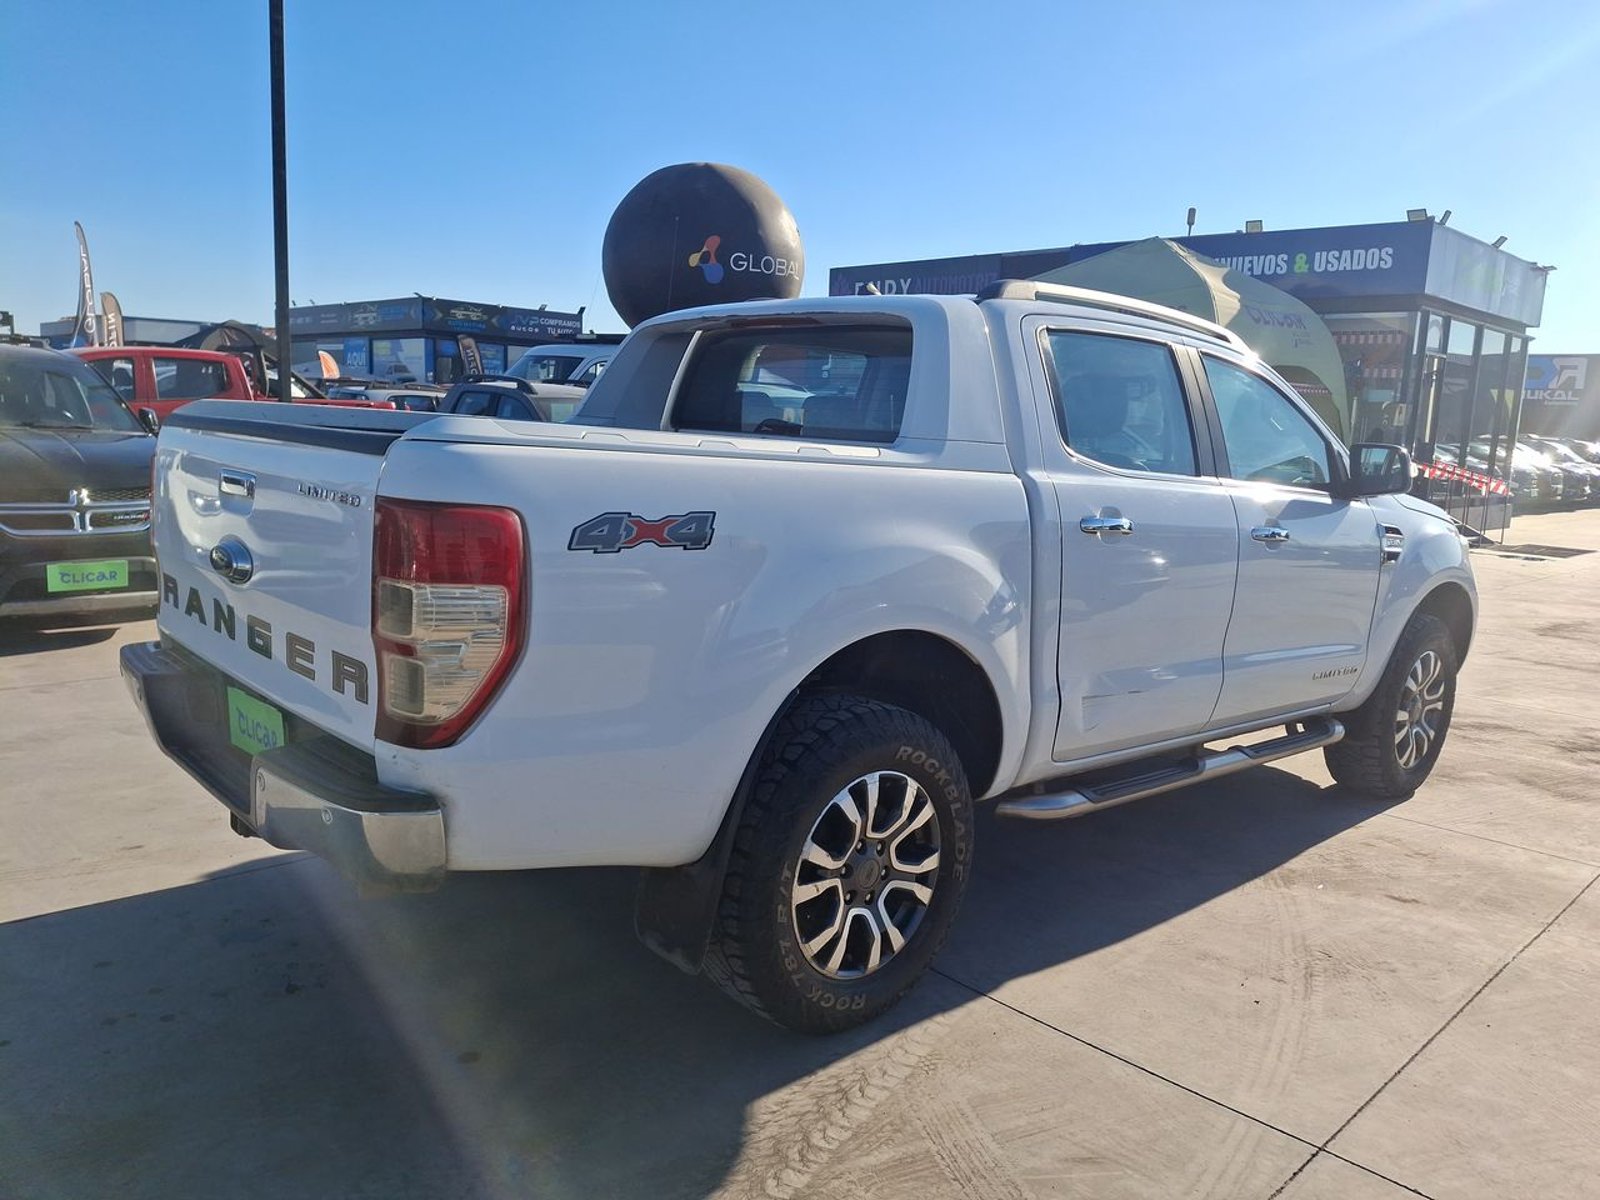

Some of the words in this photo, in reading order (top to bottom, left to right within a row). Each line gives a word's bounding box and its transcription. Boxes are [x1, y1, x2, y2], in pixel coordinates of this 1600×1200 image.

[730, 252, 800, 281] GLOBAL
[1294, 253, 1310, 273] &
[1313, 247, 1393, 272] USADOS
[1522, 389, 1580, 401] UKAL
[162, 571, 369, 705] RANGER
[804, 986, 867, 1011] ROCK
